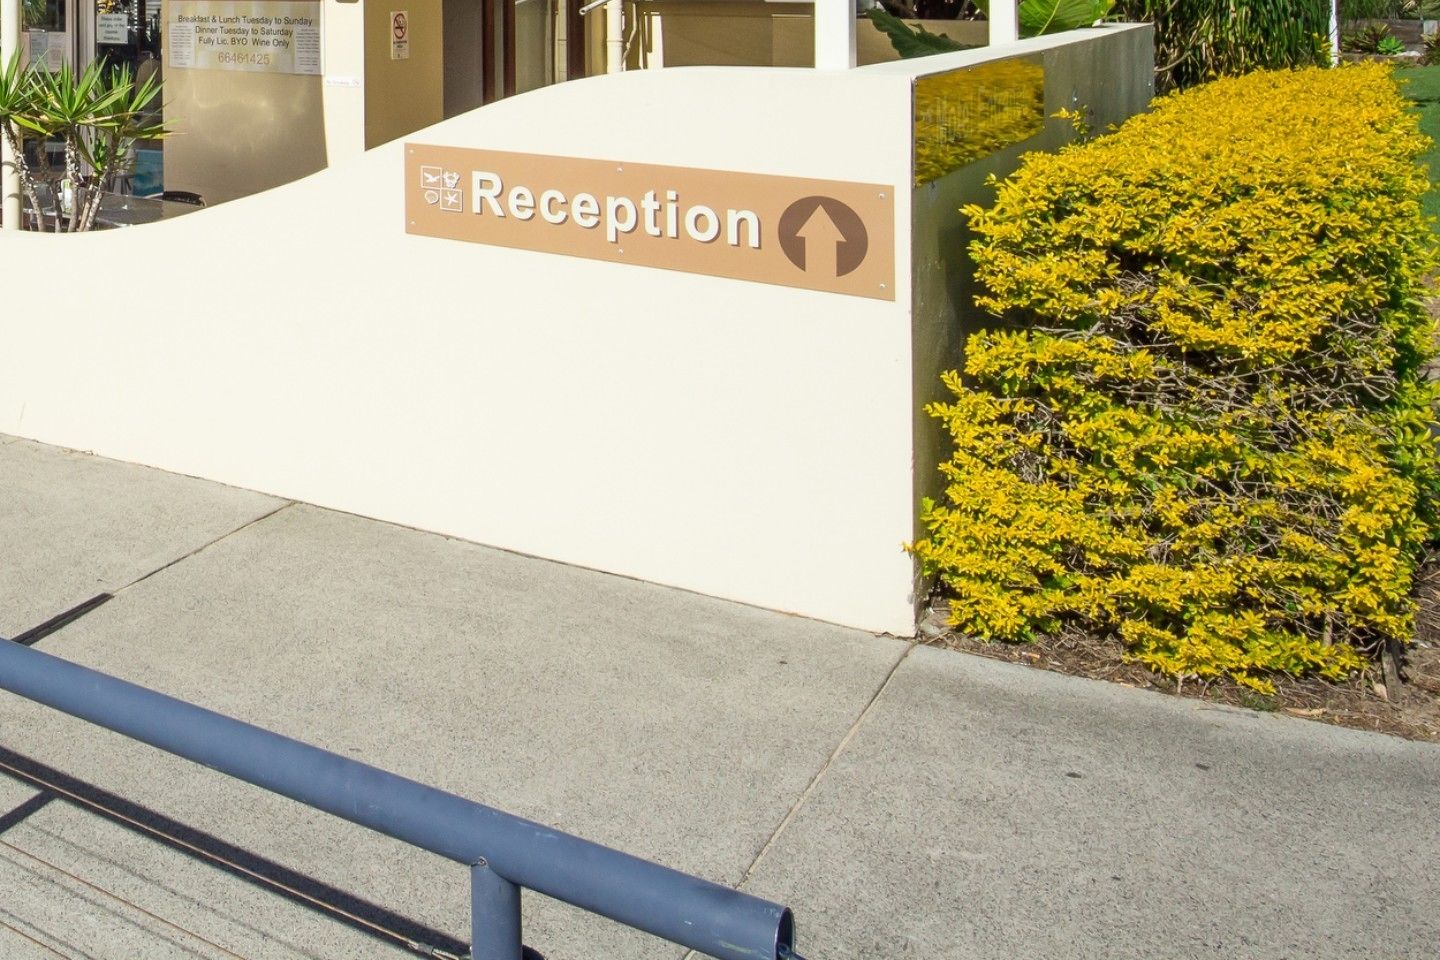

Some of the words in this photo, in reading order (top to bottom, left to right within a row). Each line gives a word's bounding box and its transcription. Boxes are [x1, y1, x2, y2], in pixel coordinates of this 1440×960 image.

[178, 14, 210, 24] Breakfast
[218, 16, 241, 24] Lunch
[242, 17, 273, 26] Tuesday
[274, 17, 282, 25] to
[283, 17, 313, 27] Sunday
[195, 25, 218, 35] Dinner
[220, 27, 250, 37] Tuesday
[250, 27, 259, 36] to
[260, 27, 294, 38] Saturday
[198, 36, 215, 46] Fully
[231, 37, 248, 47] BYO
[251, 38, 271, 47] Wine
[272, 38, 290, 49] Only
[471, 170, 762, 249] Reception
